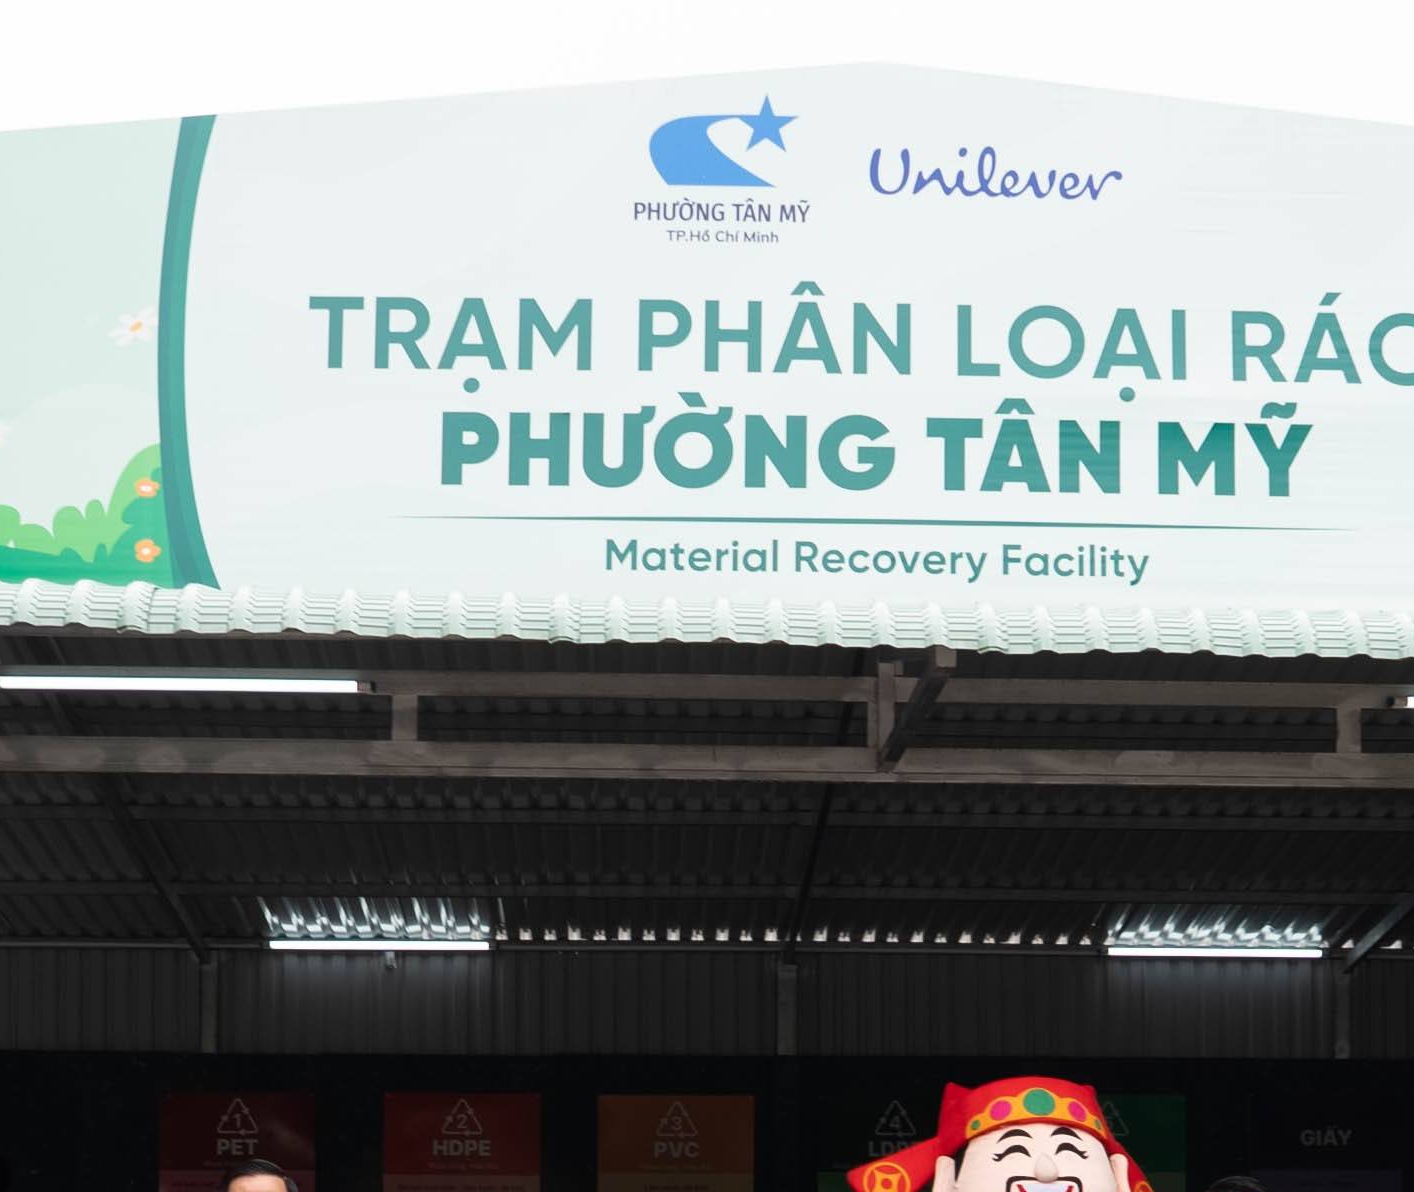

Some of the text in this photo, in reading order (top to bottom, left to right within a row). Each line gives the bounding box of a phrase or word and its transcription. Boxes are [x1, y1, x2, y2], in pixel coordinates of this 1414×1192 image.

[869, 145, 1124, 201] Unilever
[633, 196, 811, 224] PHƯỜNG TÂN MỸ
[714, 229, 740, 243] Chí
[743, 231, 779, 244] Minh
[309, 296, 593, 393] TRẠM
[637, 280, 912, 376] PHÂN
[957, 304, 1188, 403] LOẠI
[440, 391, 1314, 498] PHƯỜNG TÂN MỸ
[605, 538, 1150, 587] Material Recovery Facility
[216, 1138, 259, 1157] PET
[432, 1138, 492, 1157] HDPE
[1300, 1123, 1352, 1148] GIẤY
[653, 1140, 700, 1159] PVC
